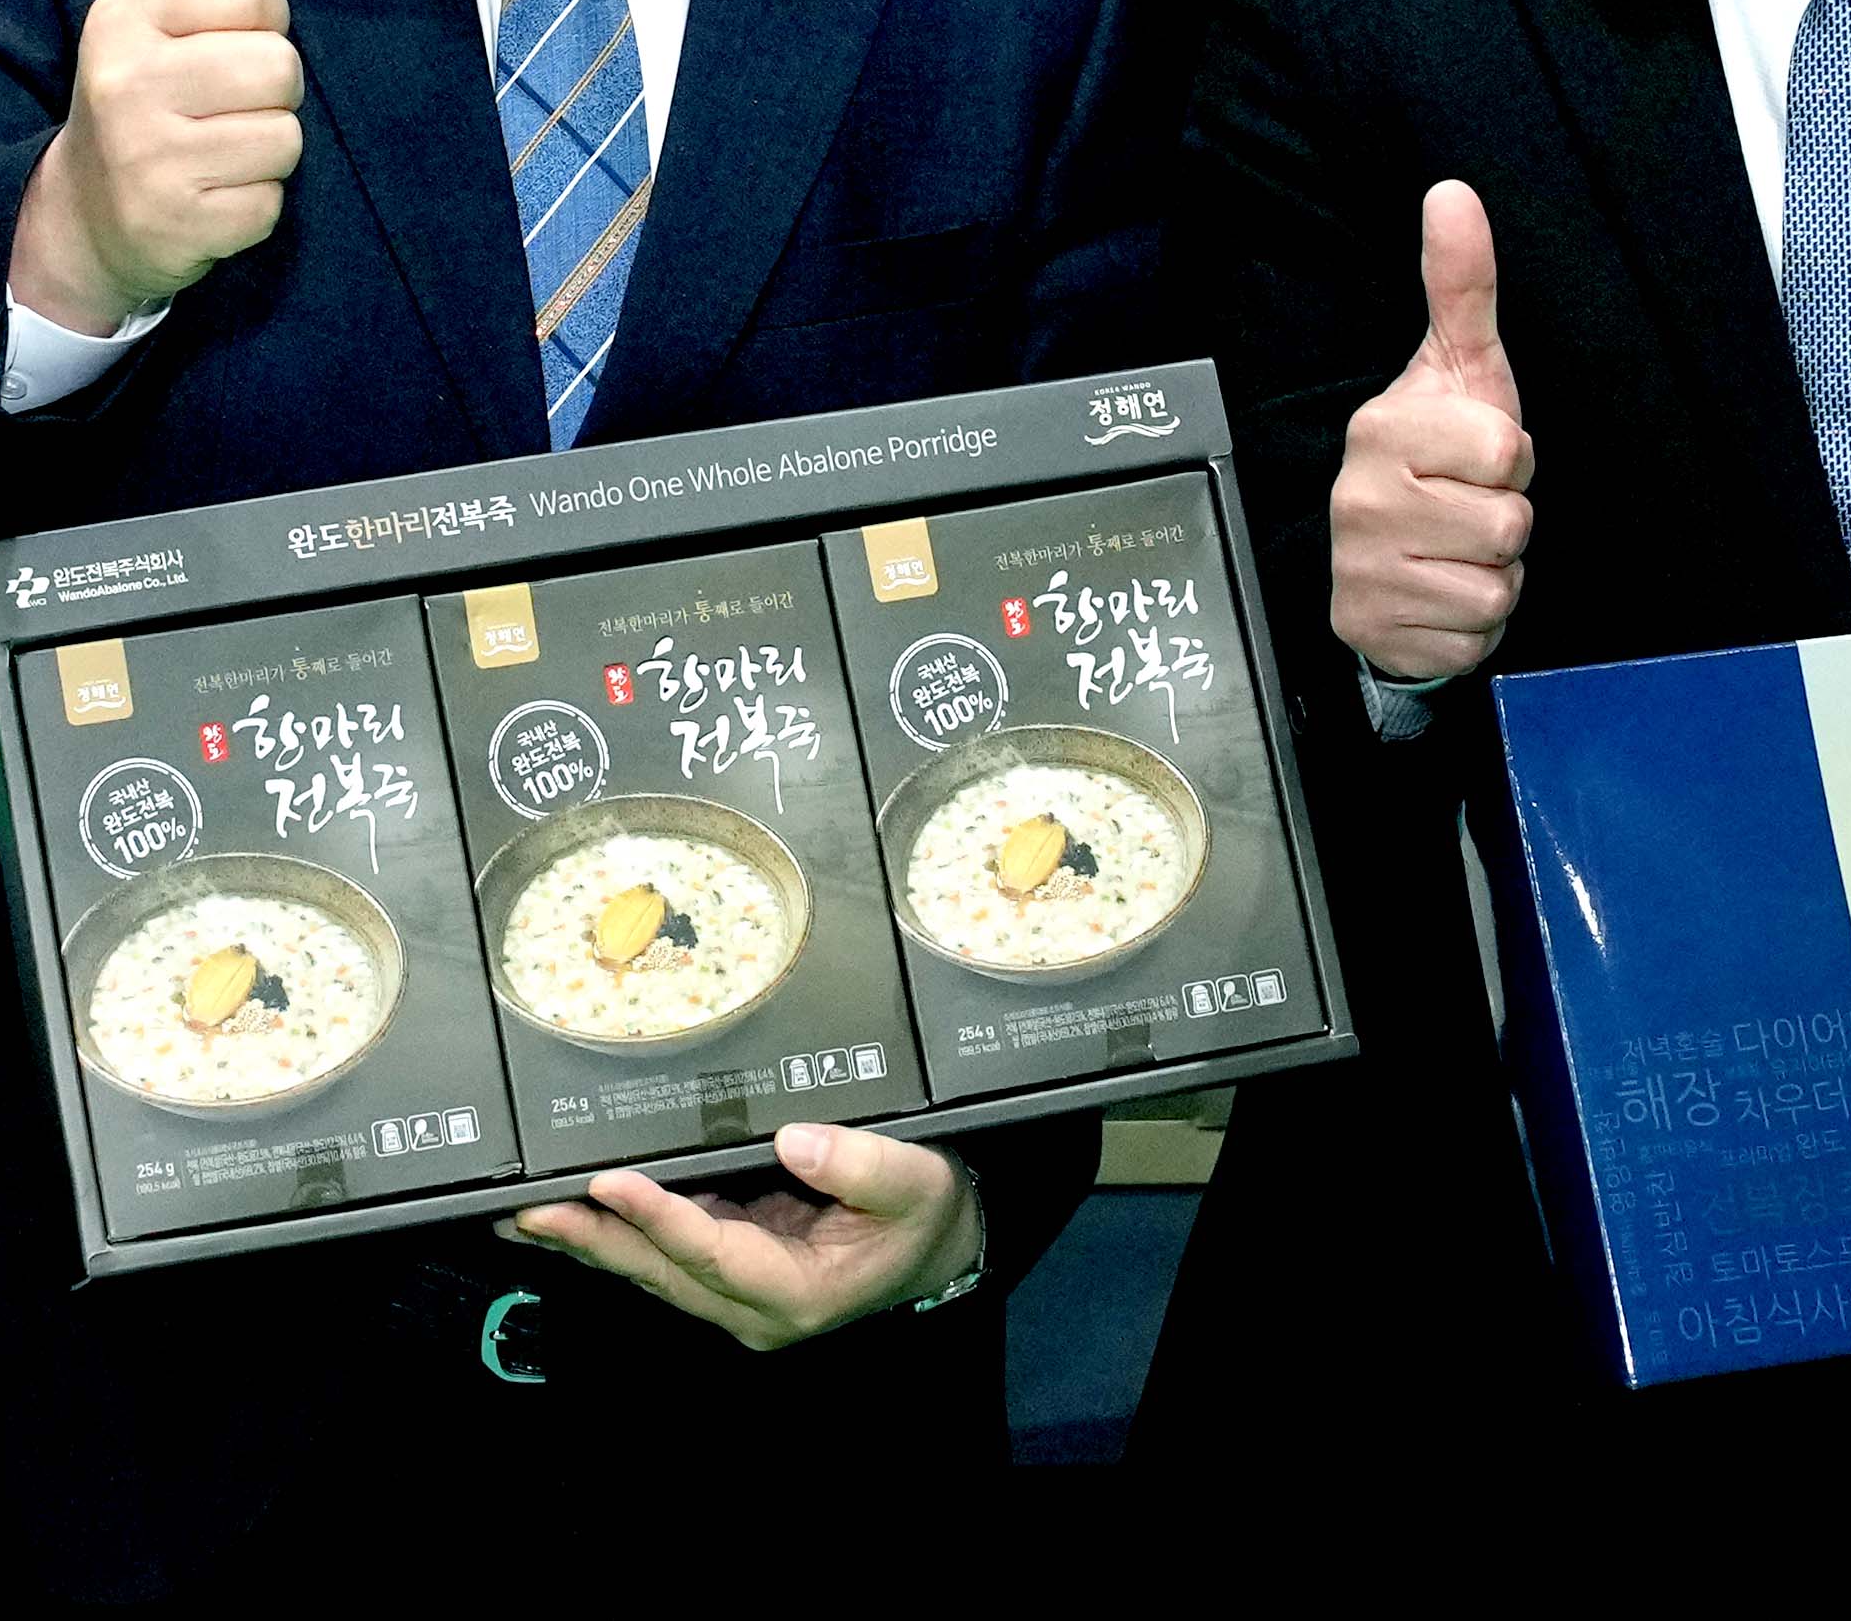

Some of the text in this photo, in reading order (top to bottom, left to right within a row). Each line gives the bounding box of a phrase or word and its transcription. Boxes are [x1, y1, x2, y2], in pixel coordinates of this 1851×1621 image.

[1088, 390, 1168, 425] 정해연
[529, 424, 999, 520] Wando One Whole Abalone Porridge
[287, 492, 518, 560] 완도한마리전복죽
[994, 525, 1185, 571] 전복한마리가 통째로 들어간
[53, 548, 184, 589] 완도전복주식회사
[167, 571, 189, 587] Ltd.
[598, 591, 795, 637] 전복한마리가 통째로 들어간
[1033, 570, 1199, 645] 한마리
[193, 647, 393, 694] 전복한마리가 통째로 들어간
[637, 636, 807, 714] 한마리
[912, 664, 981, 709] 완도전복
[917, 651, 957, 680] 국내산
[1066, 625, 1215, 745] 전복죽
[233, 694, 405, 772] 한마리
[516, 719, 558, 748] 국내산
[923, 689, 994, 736] 100%
[510, 731, 582, 776] 완도전복
[670, 693, 822, 815] 전복죽
[108, 777, 150, 806] 국내산
[522, 757, 595, 805] 100%
[102, 789, 176, 836] 완도전복
[265, 752, 419, 875] 전복죽
[113, 816, 187, 864] 100%
[958, 1024, 996, 1042] 254 g
[1621, 1028, 1724, 1065] 저녁혼술
[551, 1097, 589, 1113] 254 g
[1615, 1068, 1722, 1131] 해장
[1796, 1129, 1847, 1160] 완도
[136, 1163, 176, 1179] 254 g
[1645, 1170, 1694, 1288] 점심반찬
